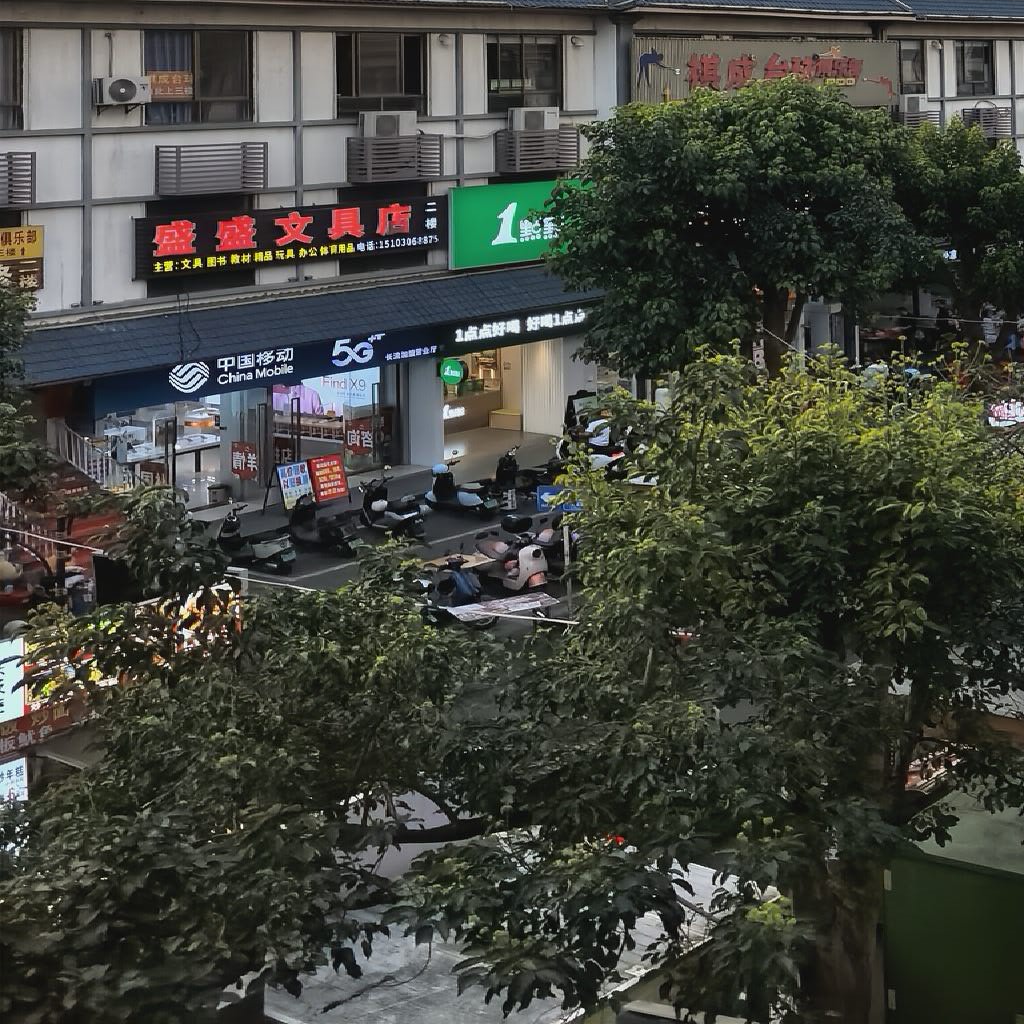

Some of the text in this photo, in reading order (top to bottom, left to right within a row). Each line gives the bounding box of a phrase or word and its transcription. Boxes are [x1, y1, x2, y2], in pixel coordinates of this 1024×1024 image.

[153, 203, 411, 256] 盛盛文具店
[217, 347, 294, 372] 中国移动
[217, 363, 294, 385] China Mobile
[322, 377, 347, 390] Find
